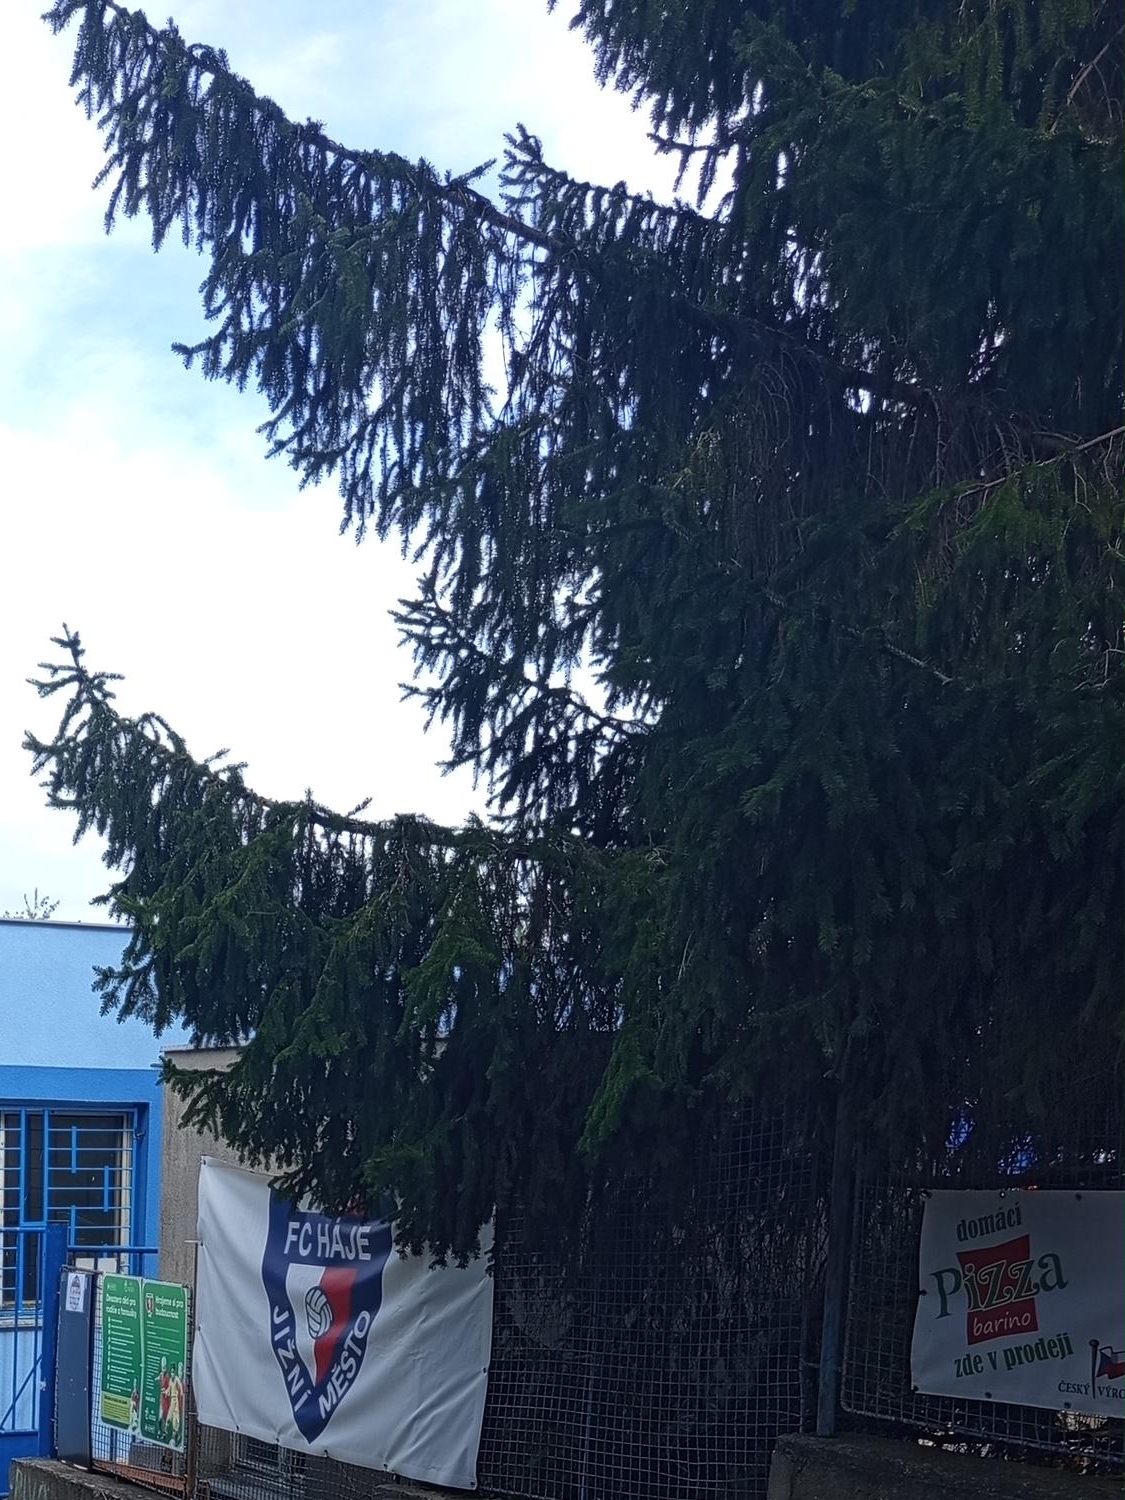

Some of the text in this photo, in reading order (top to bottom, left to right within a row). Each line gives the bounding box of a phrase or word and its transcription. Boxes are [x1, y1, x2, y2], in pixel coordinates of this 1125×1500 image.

[283, 1219, 372, 1261] FC HÁJE
[956, 1202, 1022, 1242] domácí
[973, 1311, 1031, 1336] barino
[274, 1305, 371, 1419] JIŽNÍ MĚSTO
[954, 1332, 1074, 1378] zde v prodeji
[1058, 1380, 1090, 1396] ČESKÝ
